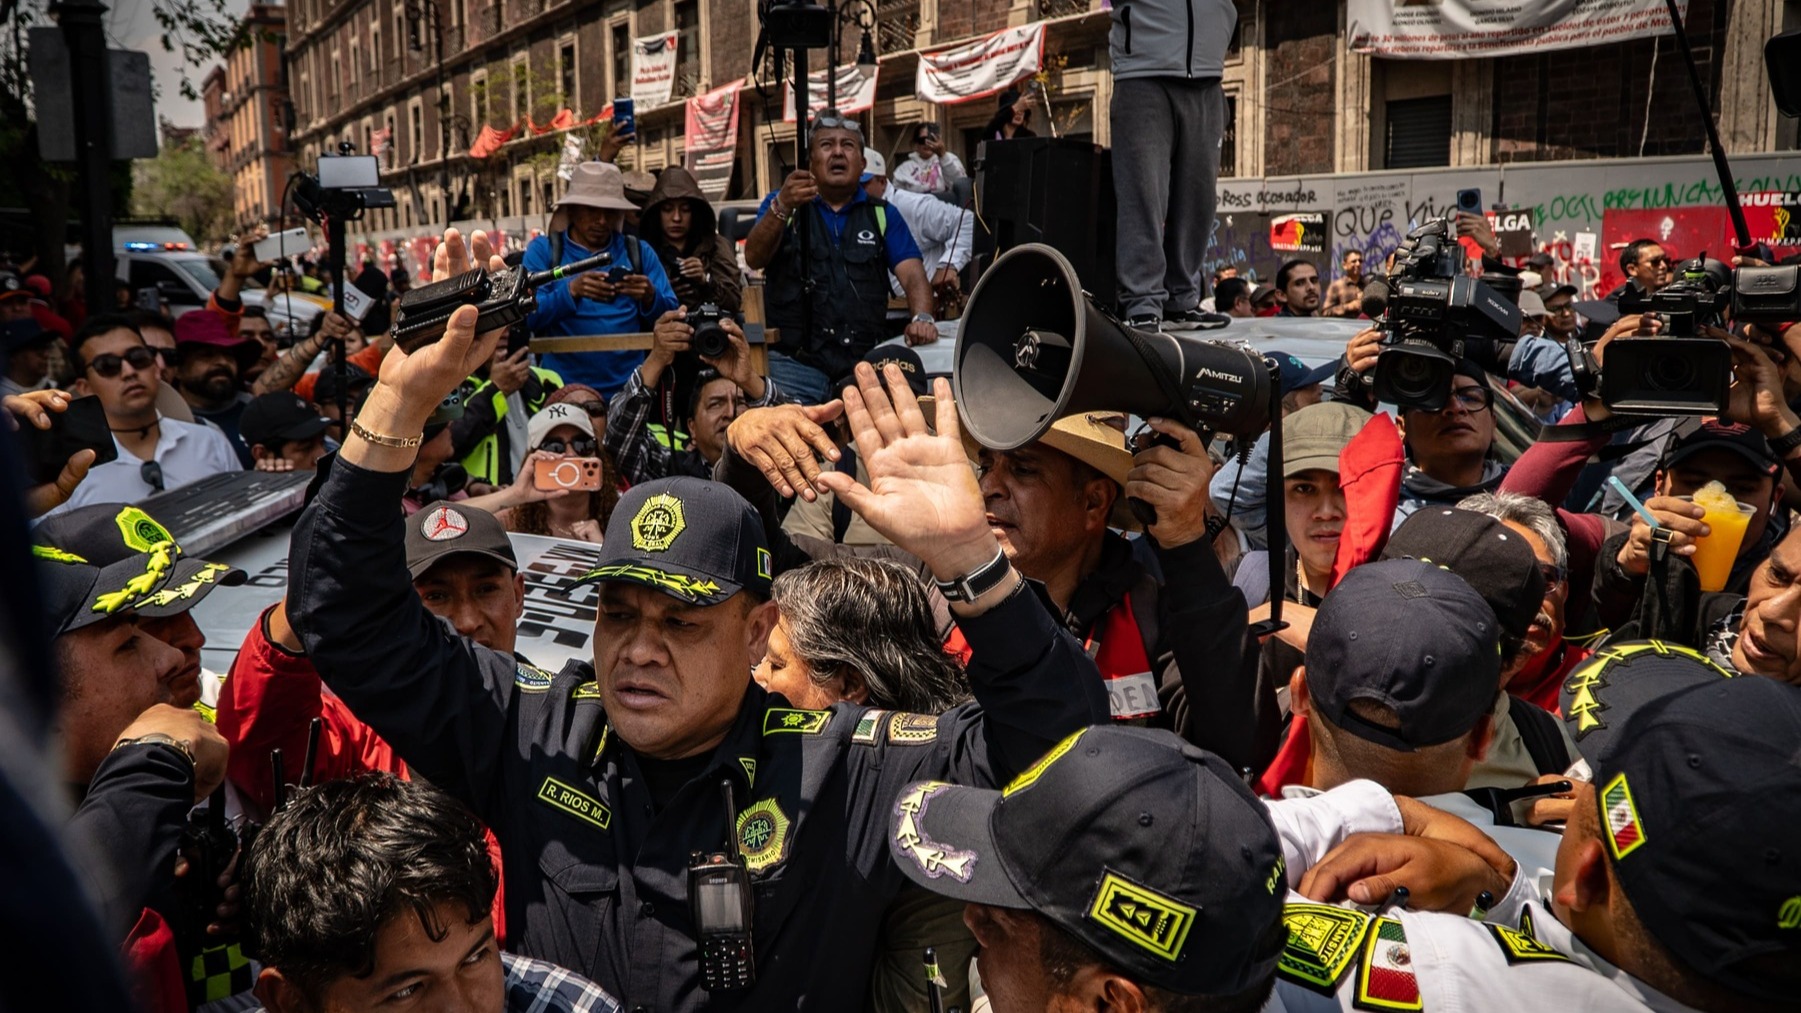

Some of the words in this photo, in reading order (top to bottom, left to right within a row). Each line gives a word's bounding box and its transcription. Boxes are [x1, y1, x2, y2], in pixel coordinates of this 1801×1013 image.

[1394, 33, 1426, 42] millones
[1428, 34, 1439, 42] de
[1532, 25, 1545, 34] en
[1583, 19, 1595, 27] de
[1592, 28, 1600, 37] el
[1602, 24, 1634, 38] pueblo
[1636, 20, 1648, 30] de
[546, 784, 557, 799] R.
[559, 791, 591, 812] RIOS
[590, 806, 604, 822] M.
